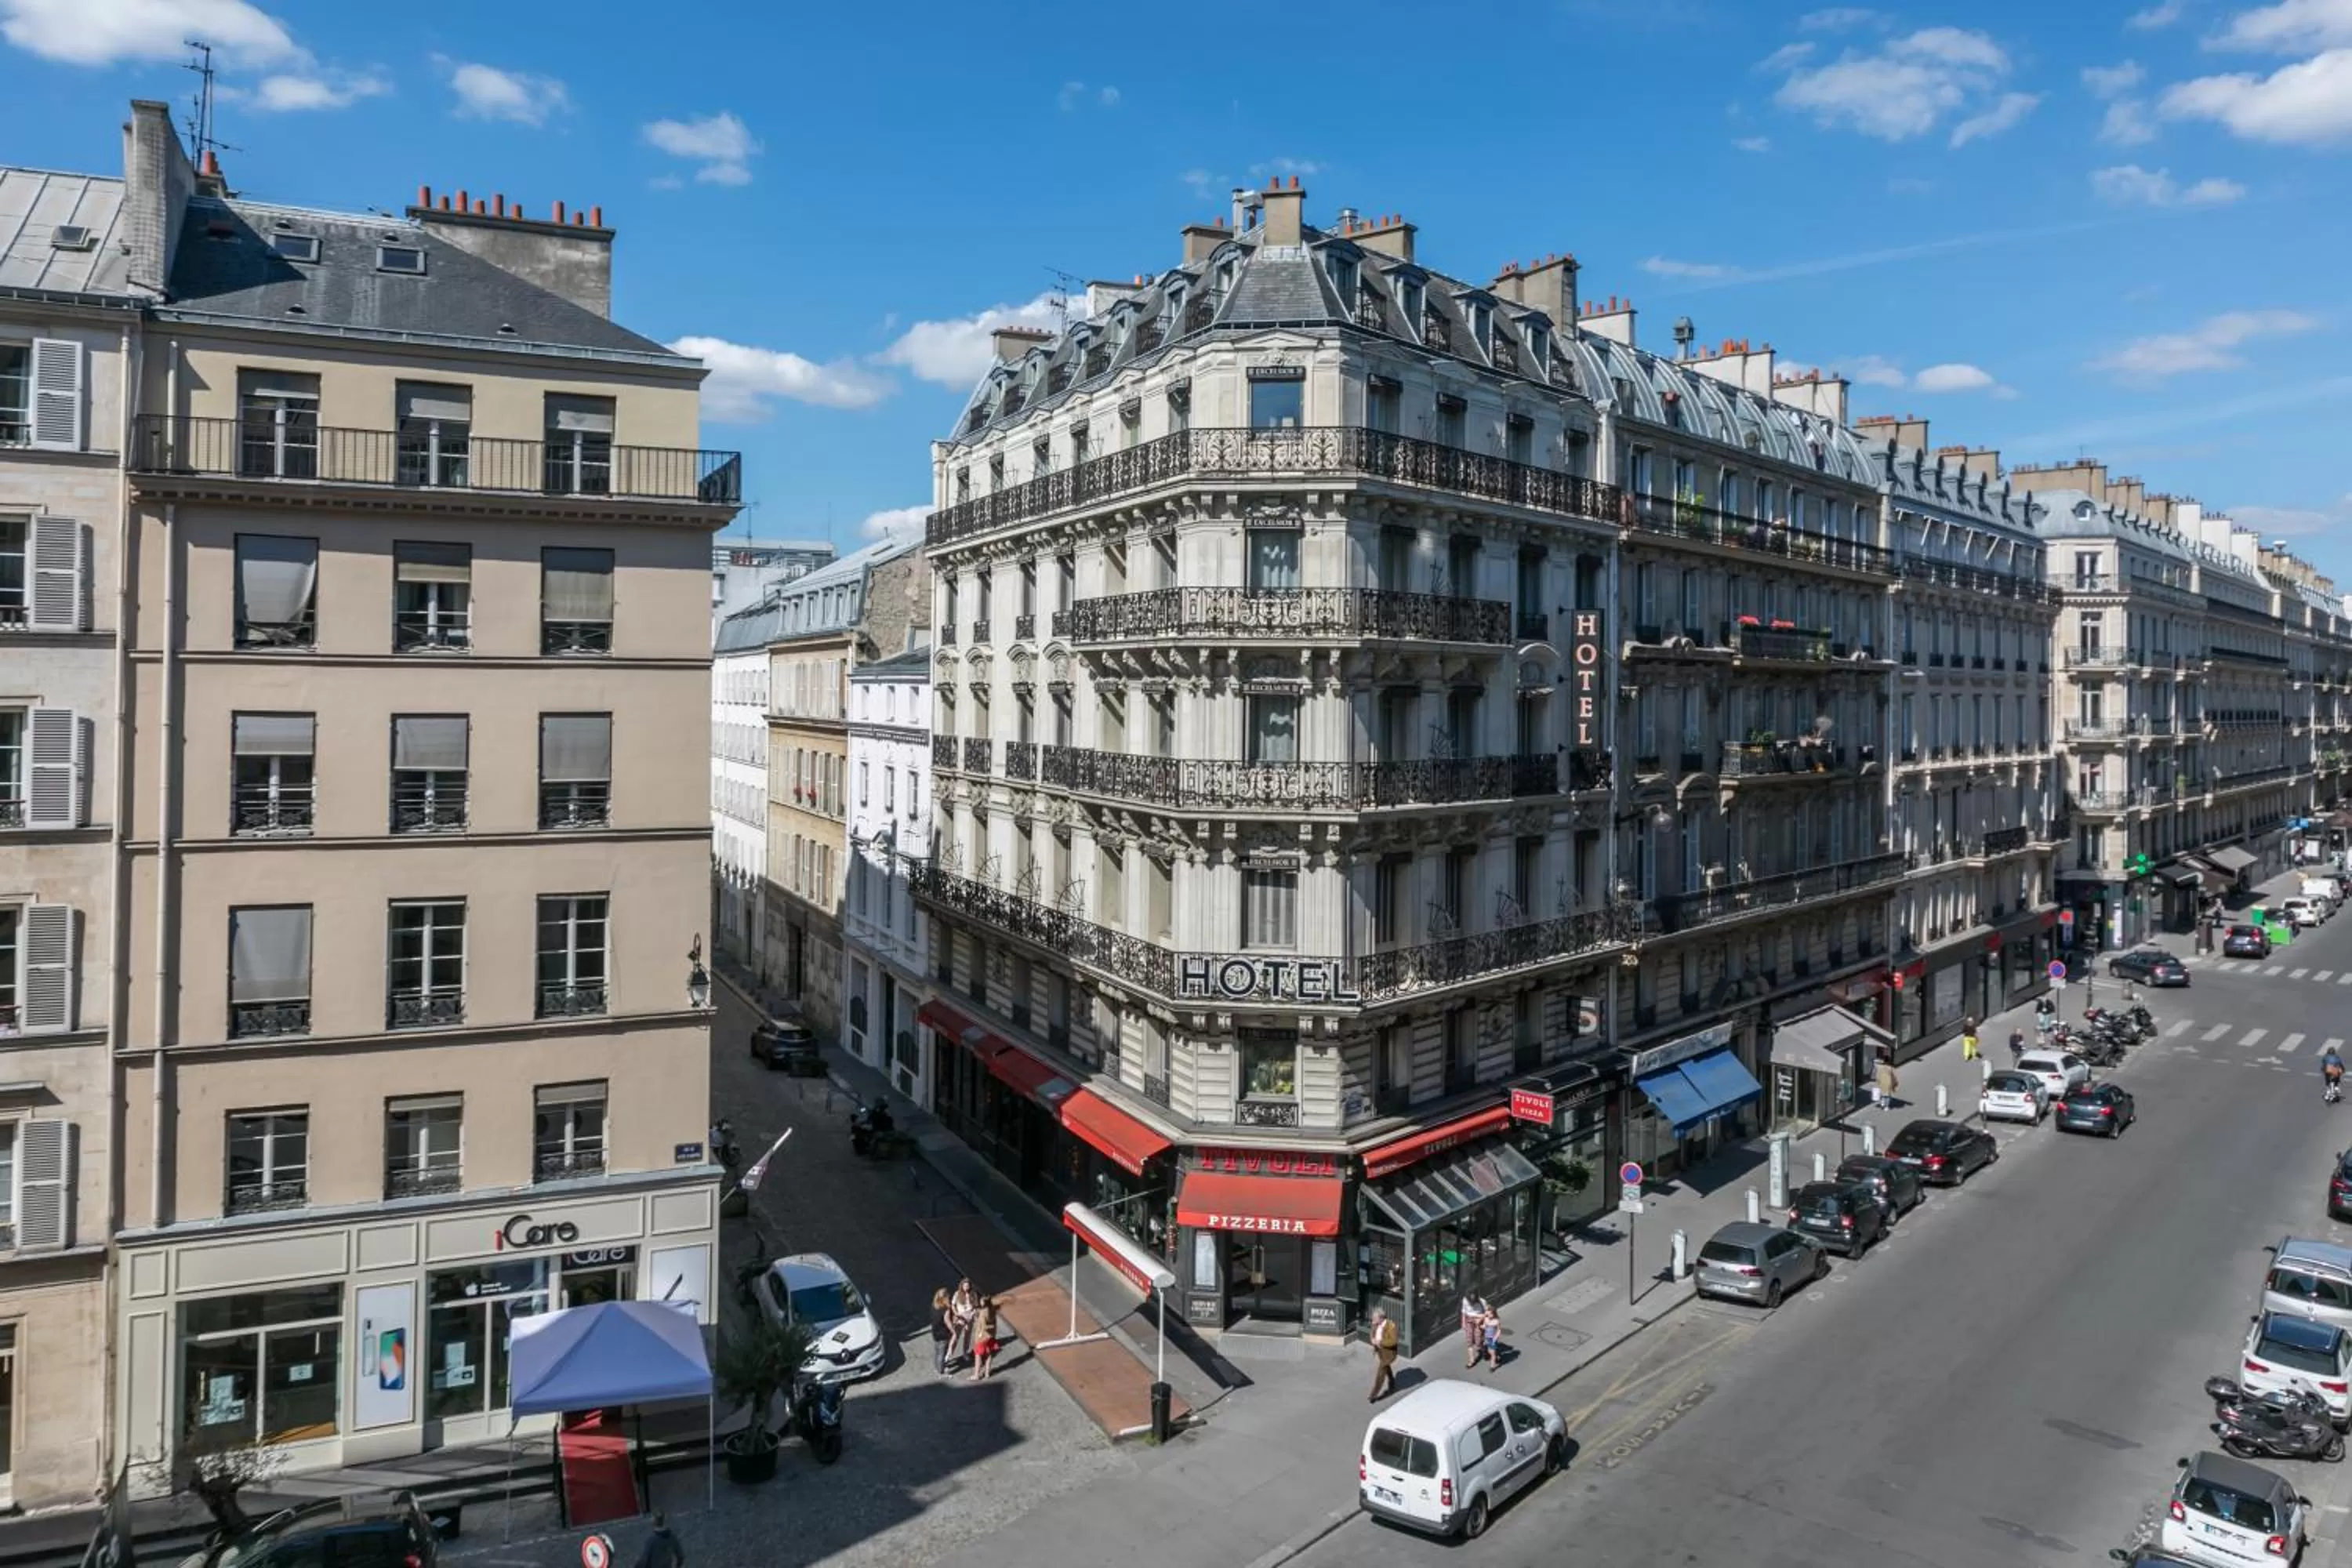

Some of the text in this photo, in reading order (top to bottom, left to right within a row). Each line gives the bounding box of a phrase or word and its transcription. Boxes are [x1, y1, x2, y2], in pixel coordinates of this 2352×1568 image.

[1576, 614, 1598, 744] HOTEL
[1179, 957, 1361, 1001] HOTEL
[1515, 1094, 1549, 1108] TIVOLI
[1199, 1149, 1337, 1177] TIVOLI
[495, 1214, 579, 1250] iCare
[1207, 1214, 1306, 1232] PIZZERIA
